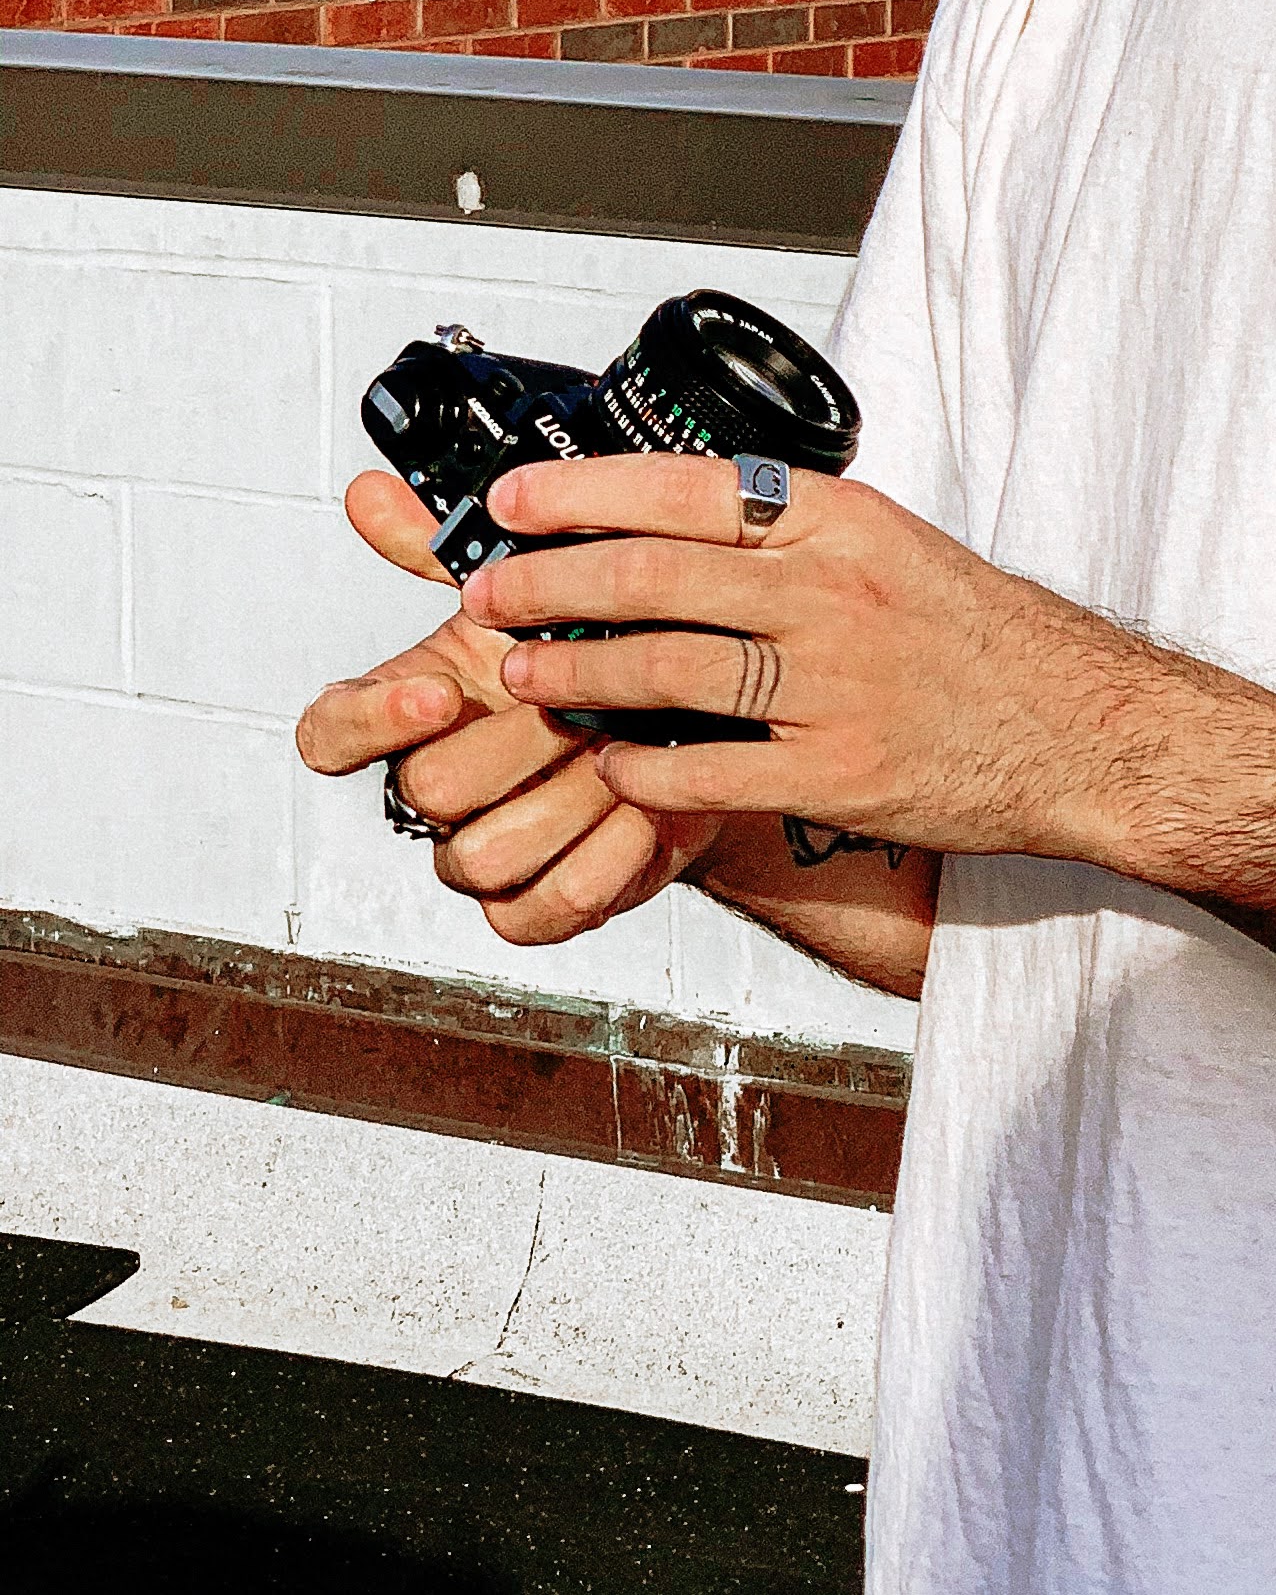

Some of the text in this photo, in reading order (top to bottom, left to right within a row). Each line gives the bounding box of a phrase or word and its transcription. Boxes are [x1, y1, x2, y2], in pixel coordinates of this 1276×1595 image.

[740, 319, 774, 344] JAPAN
[534, 414, 585, 461] non
[671, 404, 682, 417] 10
[685, 417, 696, 429] 15
[697, 429, 711, 442] 30
